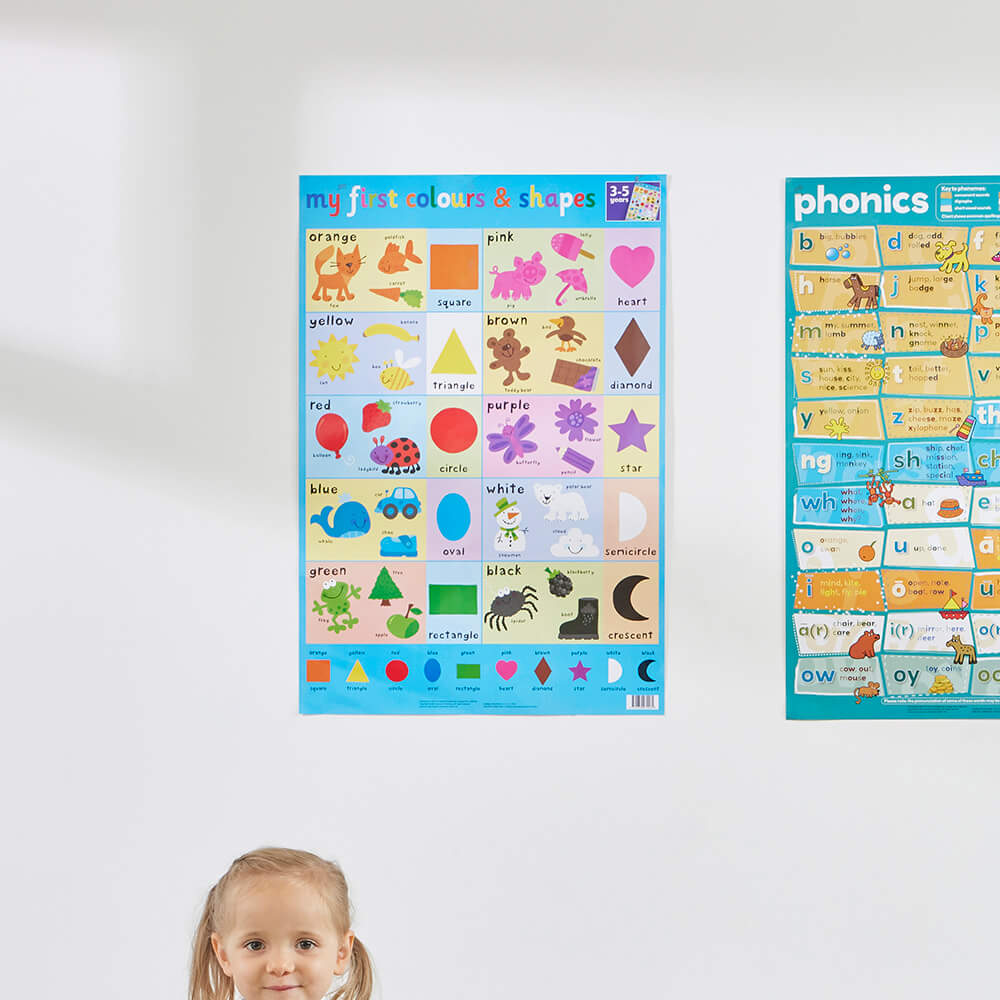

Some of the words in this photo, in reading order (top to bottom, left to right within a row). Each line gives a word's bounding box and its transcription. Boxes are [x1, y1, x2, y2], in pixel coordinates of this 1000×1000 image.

[609, 186, 629, 197] 3-5
[306, 191, 341, 217] my
[346, 185, 398, 217] first
[406, 186, 486, 208] colours
[494, 186, 511, 208] &
[519, 186, 596, 216] shapes
[794, 184, 929, 222] phonics
[309, 231, 357, 245] orange
[487, 230, 514, 247] pink
[800, 233, 813, 250] b
[888, 232, 901, 250] d
[974, 230, 984, 250] f
[800, 275, 813, 294] h
[891, 275, 898, 297] j
[975, 275, 986, 292] k
[437, 299, 472, 310] square
[617, 297, 647, 306] heart
[309, 314, 354, 329] yellow
[487, 314, 528, 326] brown
[800, 326, 821, 338] m
[891, 326, 904, 338] n
[976, 325, 988, 342] p
[801, 371, 812, 382] s
[893, 365, 903, 383] t
[978, 370, 990, 381] v
[432, 381, 475, 392] triangle
[610, 380, 653, 390] diamond
[309, 399, 331, 411] red
[487, 399, 530, 414] purple
[801, 413, 813, 429] y
[893, 412, 903, 424] z
[801, 454, 831, 473] ng
[895, 451, 920, 468] sh
[439, 464, 468, 473] circle
[620, 463, 643, 473] star
[310, 483, 338, 495] blue
[486, 482, 525, 495] white
[801, 492, 835, 510] wh
[903, 497, 914, 509] a
[978, 497, 990, 509] e
[442, 547, 465, 556] oval
[605, 547, 657, 556] semicircle
[802, 541, 813, 553] o
[895, 541, 907, 552] u
[309, 566, 347, 579] green
[486, 563, 522, 577] black
[428, 630, 479, 642] rectangle
[608, 631, 653, 640] crescent
[802, 671, 835, 682] ow
[894, 671, 919, 686] oy
